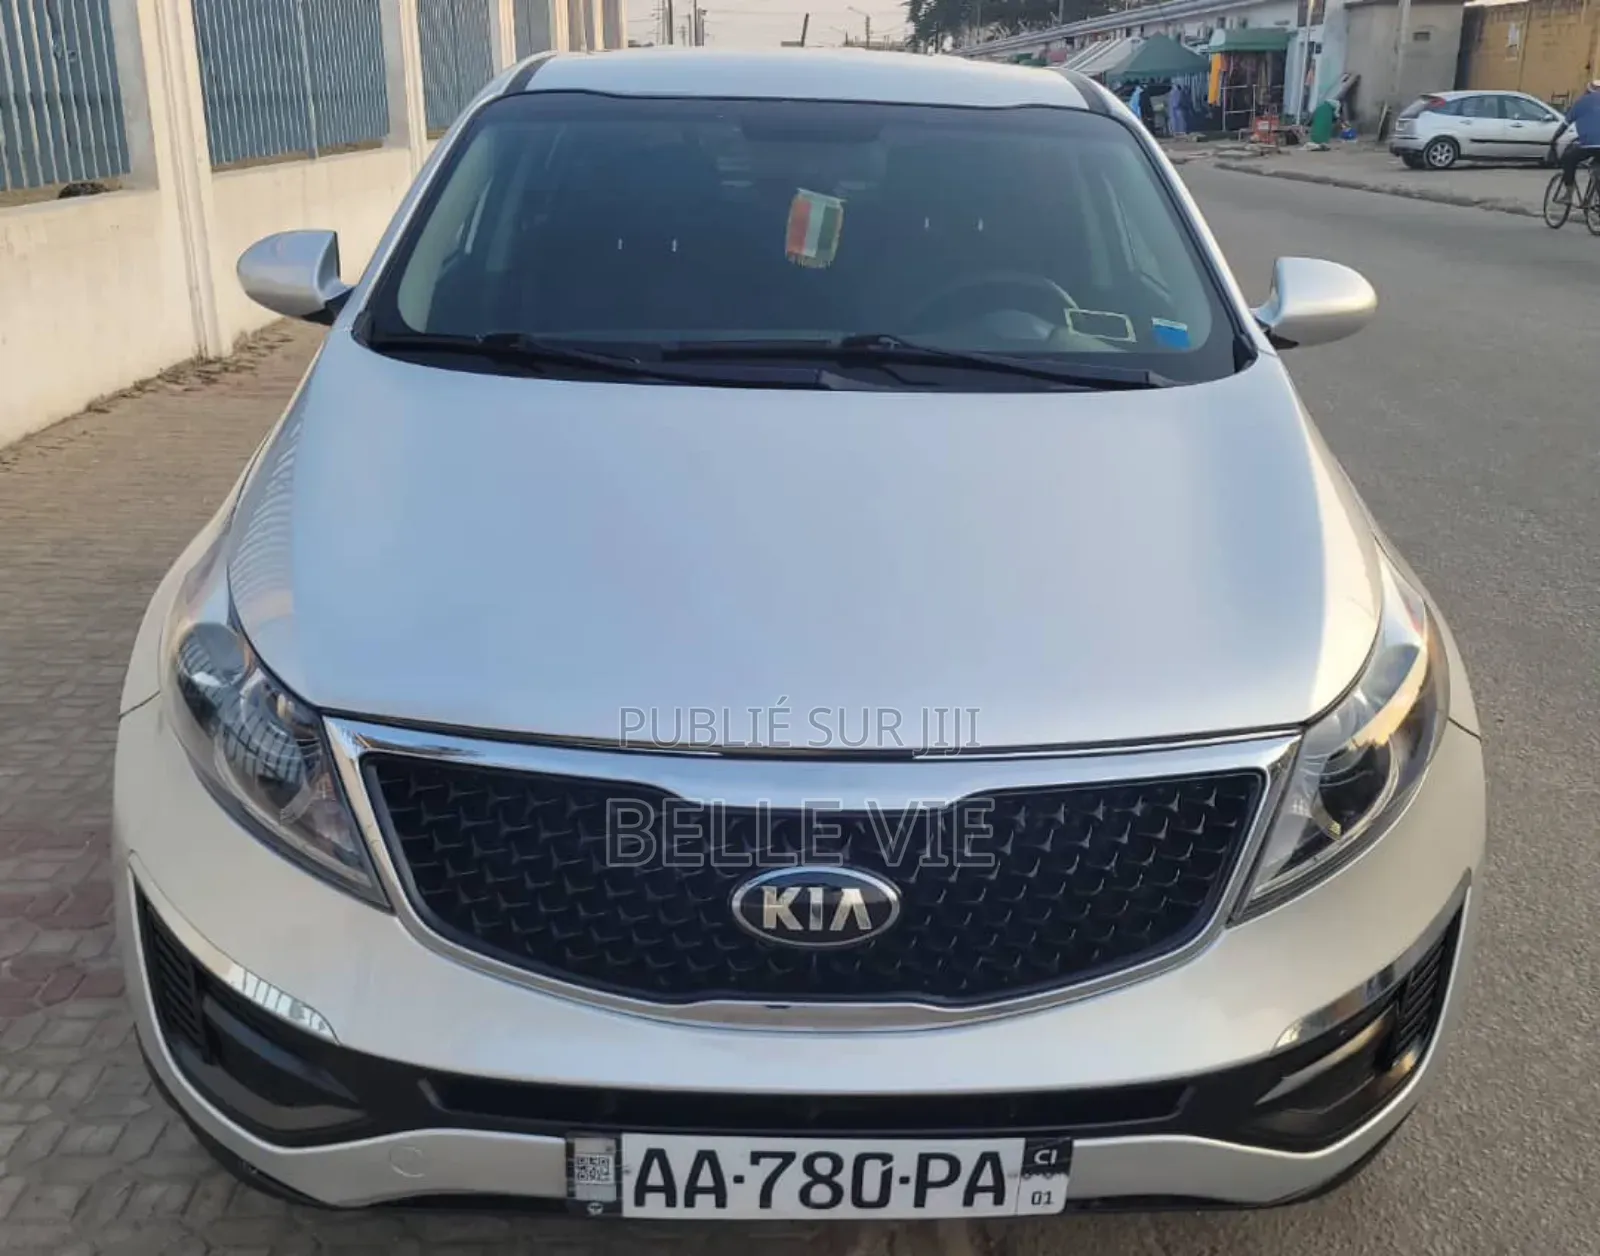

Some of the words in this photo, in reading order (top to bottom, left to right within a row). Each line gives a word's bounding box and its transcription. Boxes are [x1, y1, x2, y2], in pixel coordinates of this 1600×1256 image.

[760, 885, 873, 932] KIA
[1033, 1149, 1058, 1165] CI
[1031, 1190, 1053, 1206] 01
